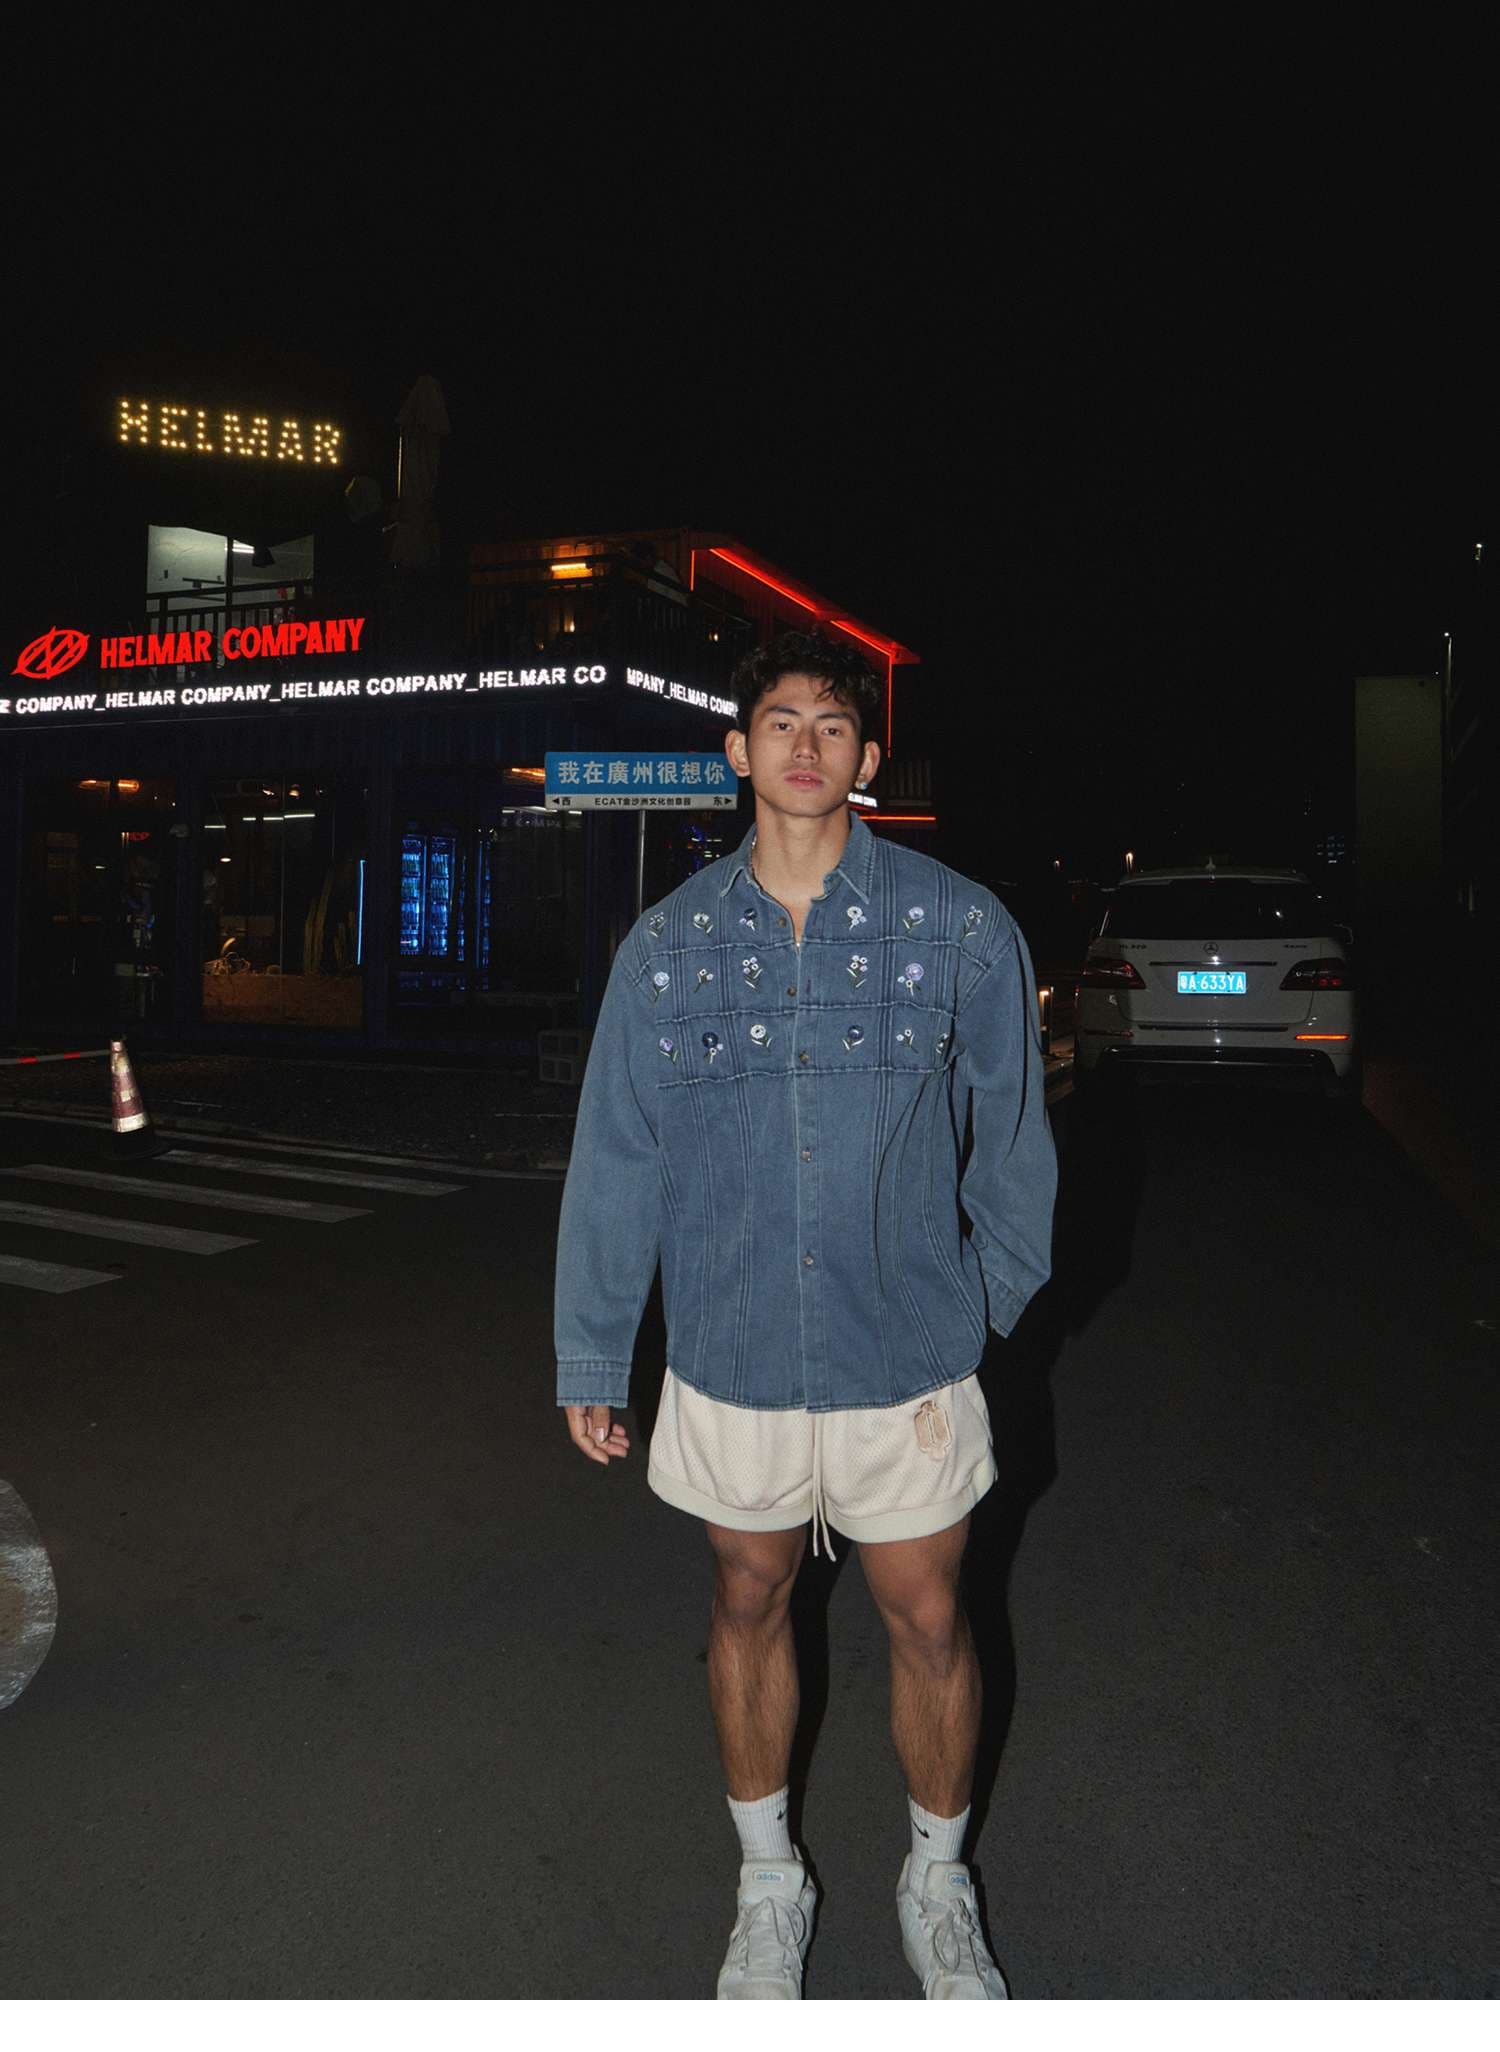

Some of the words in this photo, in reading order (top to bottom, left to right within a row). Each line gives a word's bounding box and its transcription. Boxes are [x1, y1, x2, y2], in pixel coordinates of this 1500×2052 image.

[120, 400, 341, 465] HELMAR
[101, 630, 212, 668] HELMAR
[222, 618, 365, 660] COMPANY
[573, 665, 607, 684] CO
[558, 761, 726, 785] 我在廣州很想你
[562, 796, 571, 806] 西
[713, 796, 723, 806] 东
